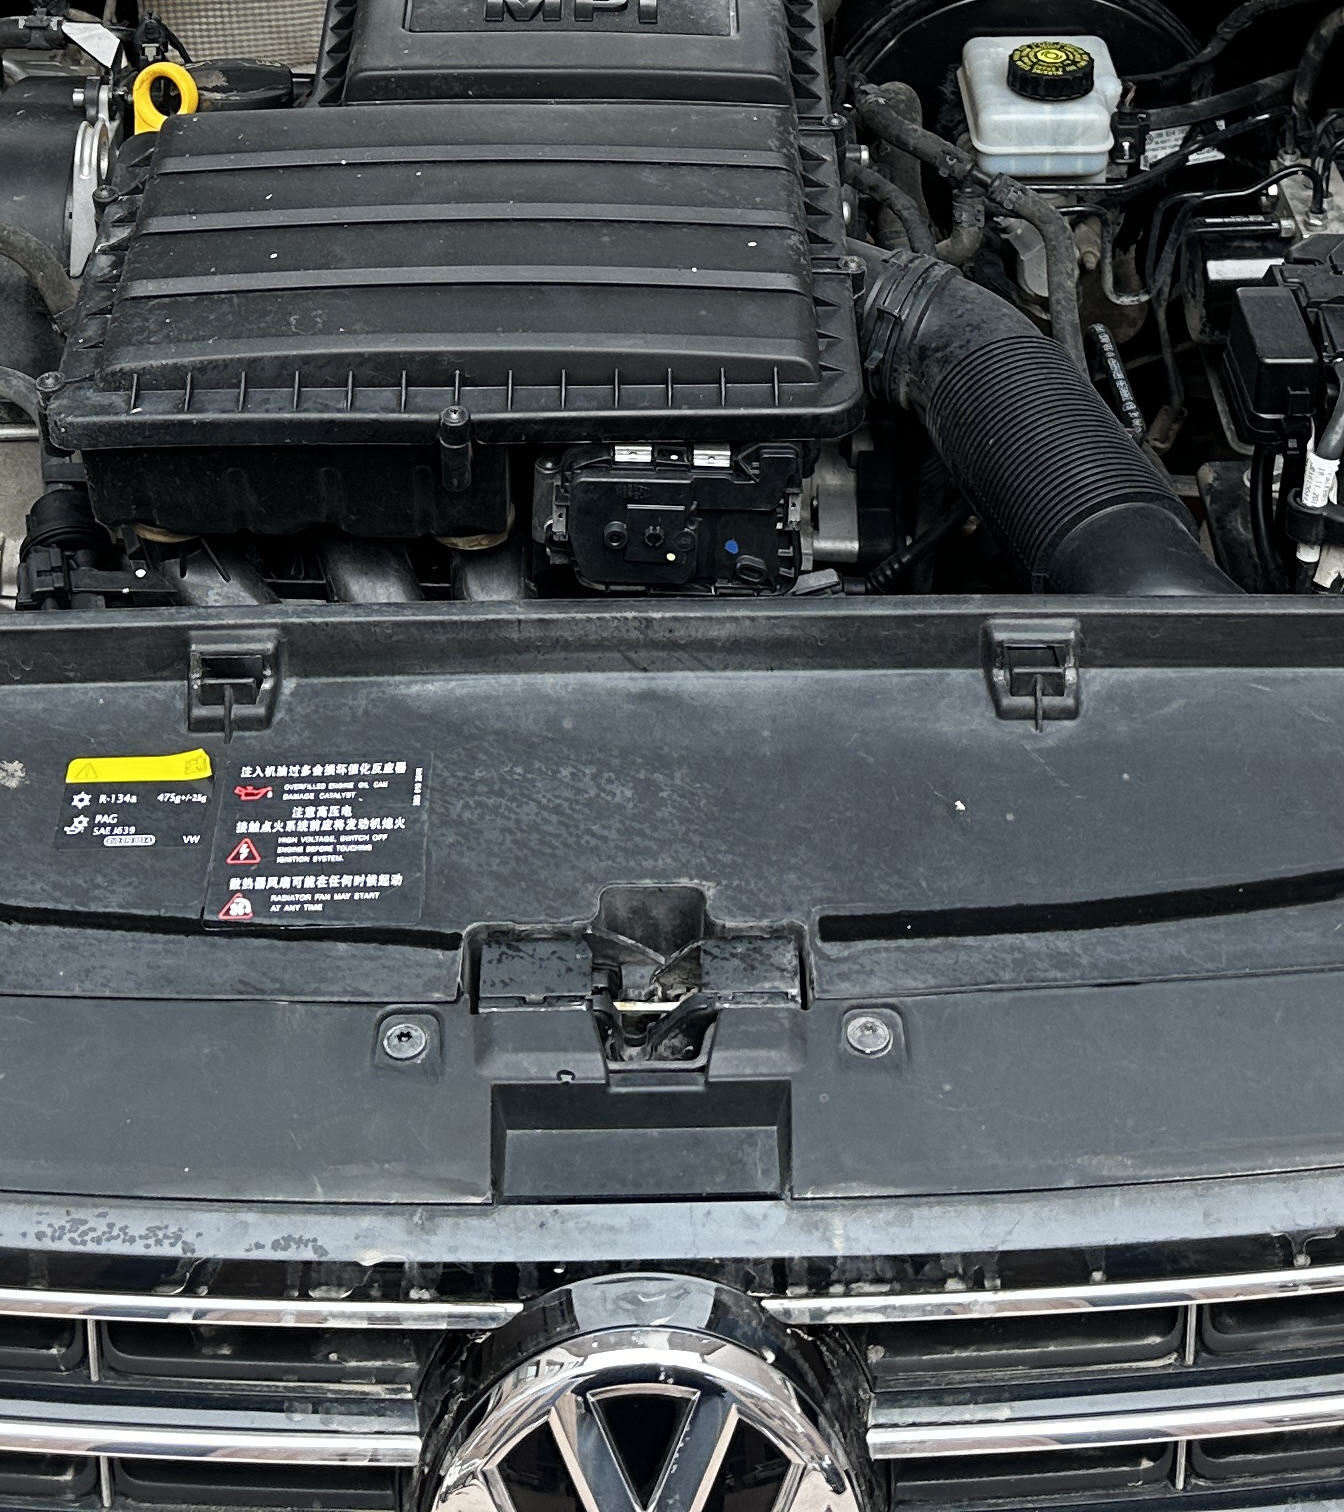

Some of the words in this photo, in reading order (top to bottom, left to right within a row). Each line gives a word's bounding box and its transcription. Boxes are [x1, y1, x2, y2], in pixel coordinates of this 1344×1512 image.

[98, 793, 138, 804] R-134a
[291, 804, 353, 819] 注意高压电
[94, 813, 119, 824] PAG
[92, 826, 112, 836] SAE
[112, 826, 136, 835] J639
[182, 834, 201, 844] VW
[277, 836, 298, 844] HIGH
[339, 834, 370, 842] SWITCH
[371, 833, 389, 842] OFF
[269, 893, 312, 902] RADIATOR
[314, 893, 331, 901] FAN
[333, 892, 352, 900] MAY
[353, 891, 381, 900] START
[269, 904, 282, 912] AT
[283, 904, 302, 912] ANY
[303, 903, 323, 911] TIME
